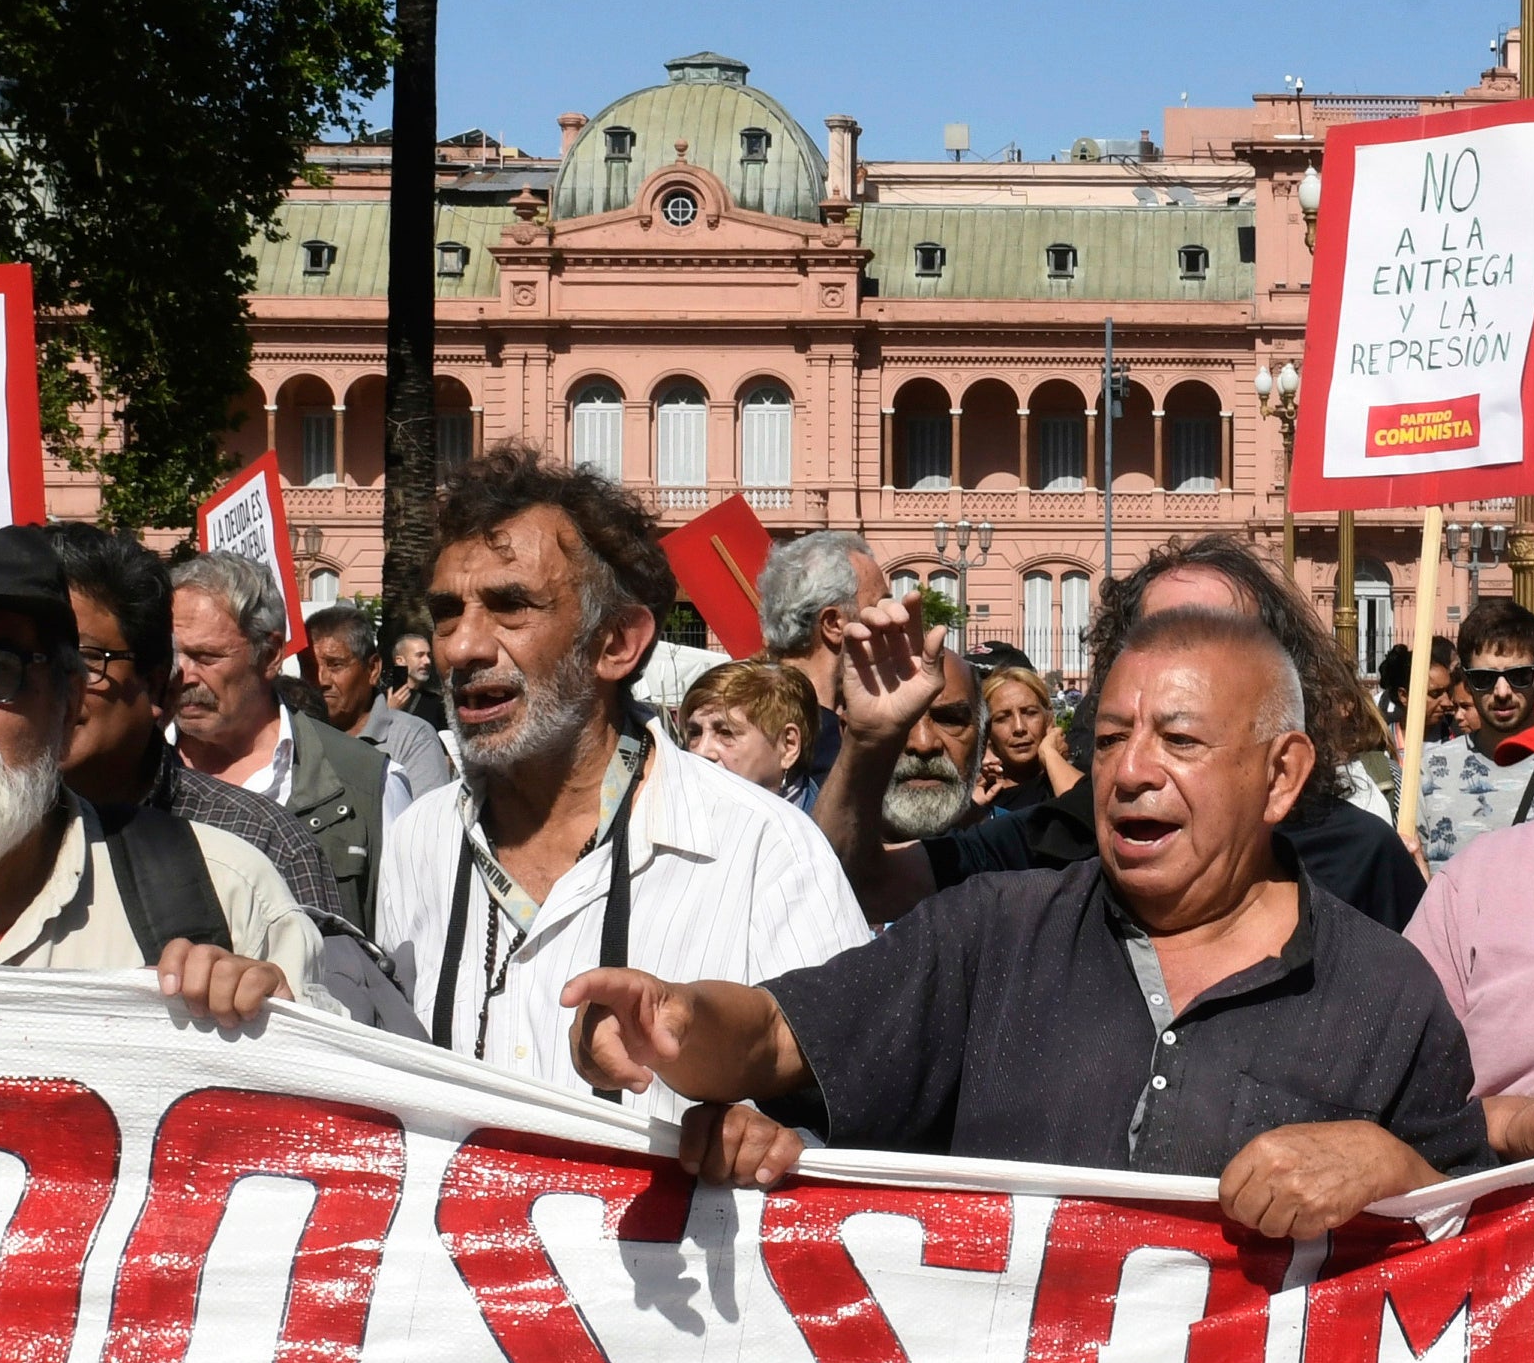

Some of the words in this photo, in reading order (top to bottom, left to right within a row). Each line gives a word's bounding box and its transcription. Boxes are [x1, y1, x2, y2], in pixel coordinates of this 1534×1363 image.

[1421, 147, 1480, 213] NO
[1395, 227, 1415, 257] A
[1442, 217, 1483, 251] LA
[1372, 253, 1514, 295] ENTREGA
[1399, 303, 1415, 333] Y
[1439, 296, 1477, 329] LA
[1374, 419, 1473, 446] COMUNISTA
[1400, 410, 1452, 426] PARTIDO
[213, 519, 225, 549] LA
[224, 499, 252, 542] DEUDA
[251, 489, 263, 522] ES
[471, 842, 513, 898] ARGENTINA
